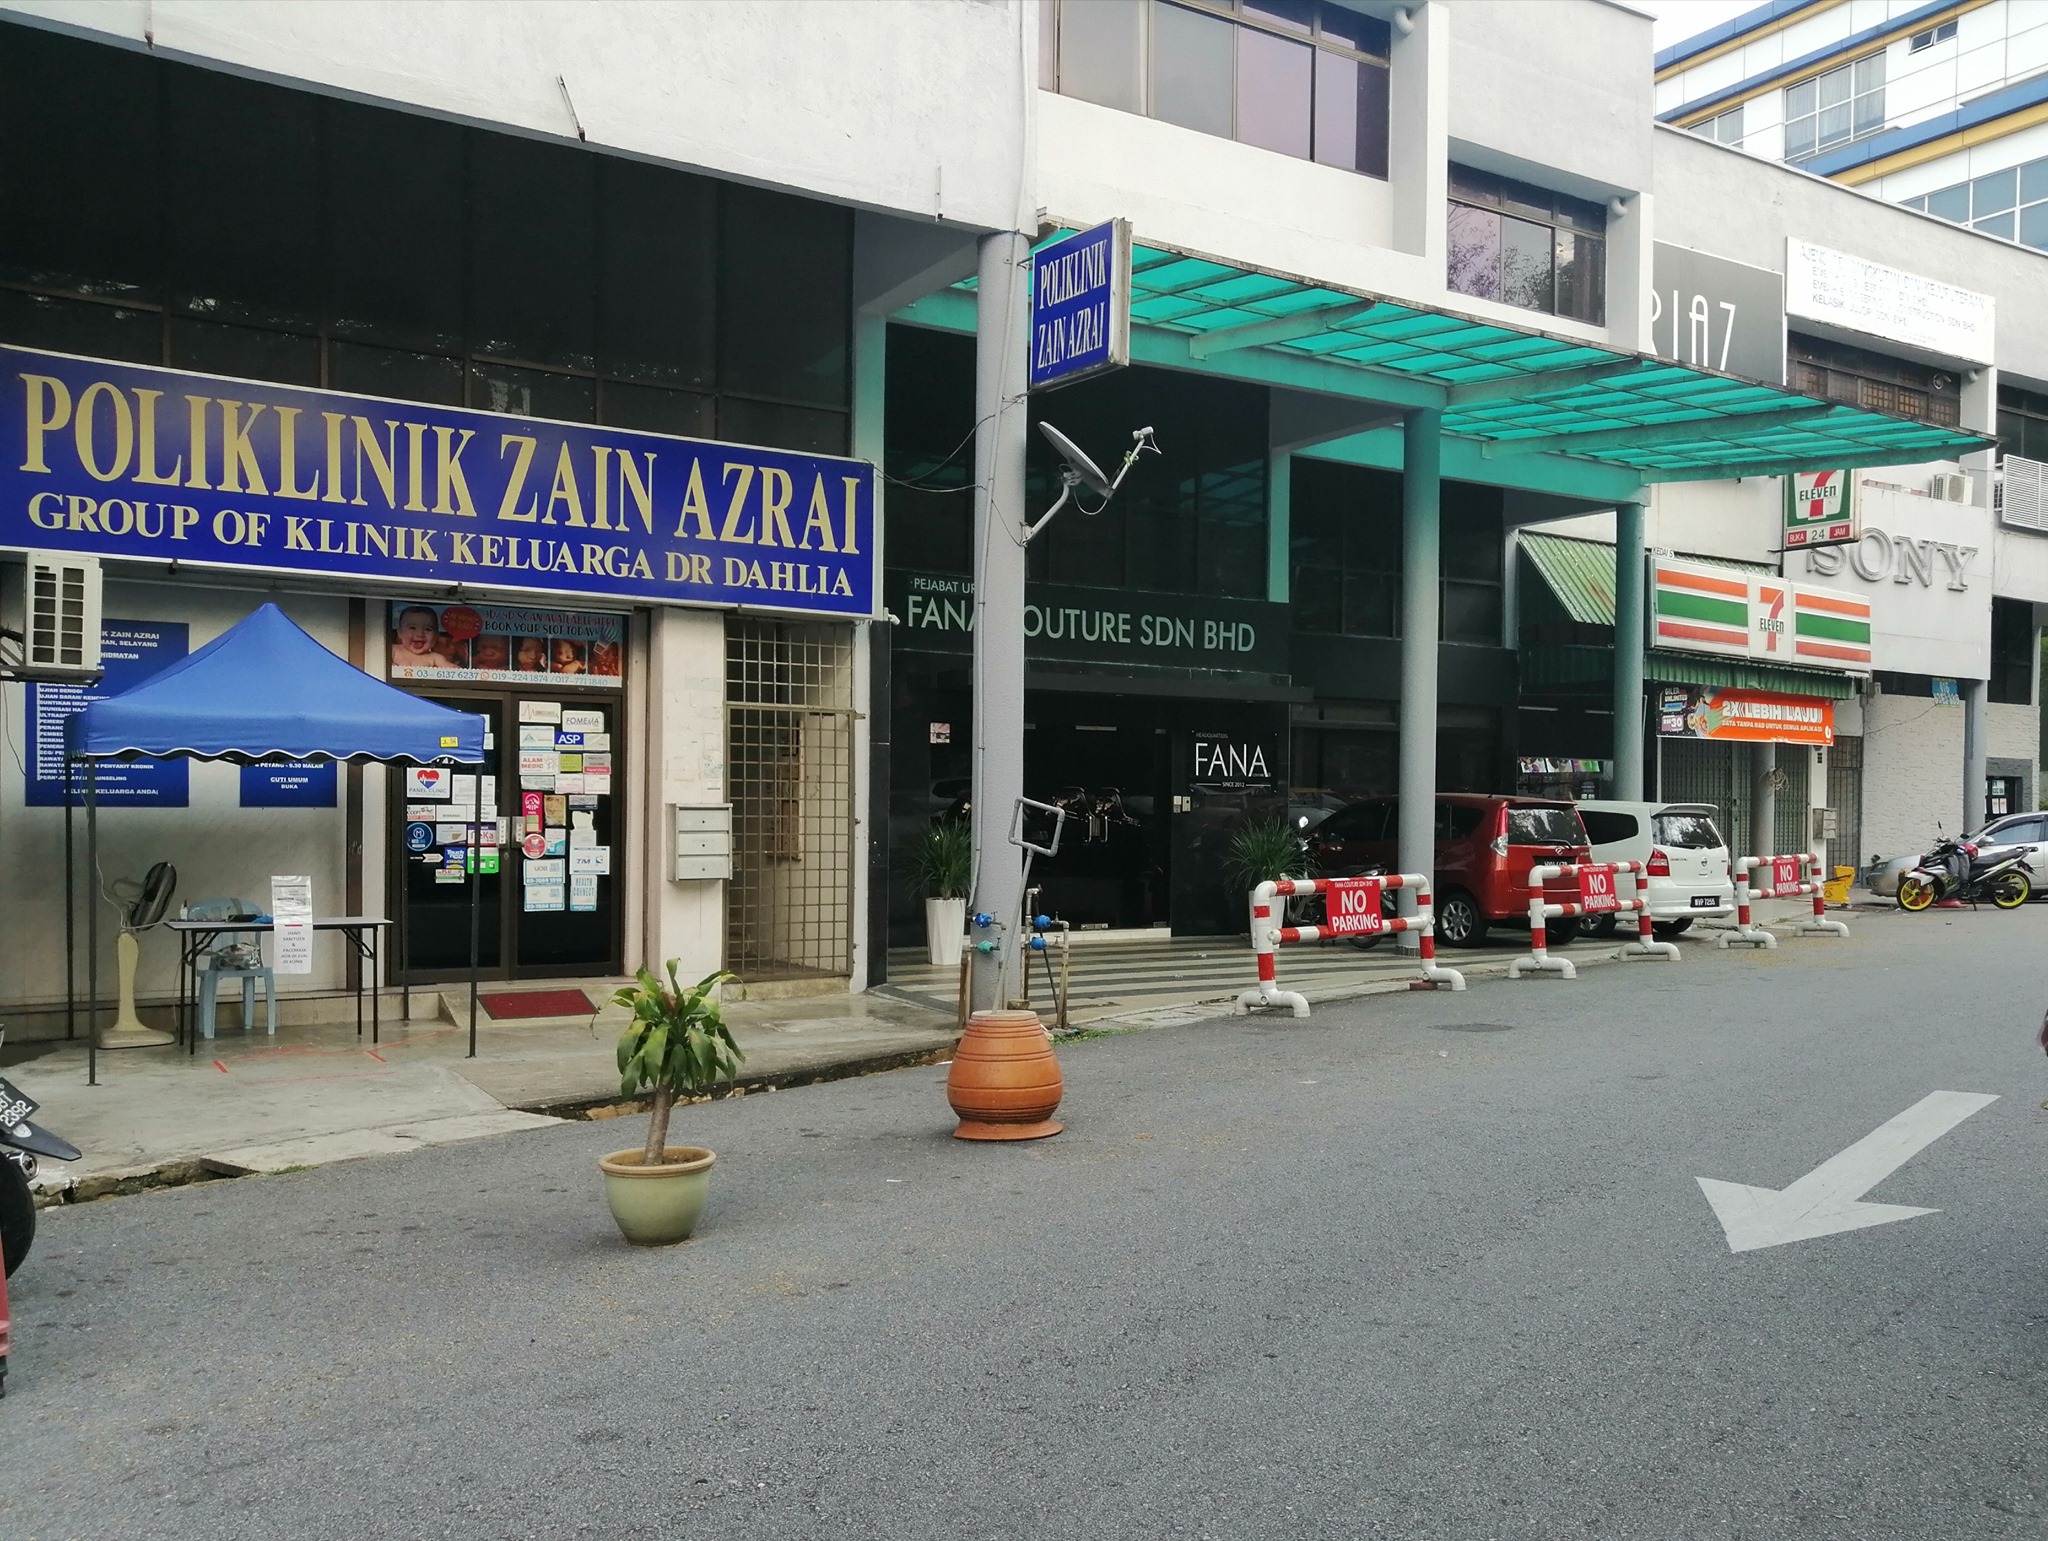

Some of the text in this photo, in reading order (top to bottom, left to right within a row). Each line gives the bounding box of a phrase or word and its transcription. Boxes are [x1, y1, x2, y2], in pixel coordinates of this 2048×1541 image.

[1039, 239, 1107, 309] POLIKLINIK
[1037, 302, 1105, 369] ZAIN AZRAI
[19, 373, 860, 555] POLIKLINIK ZAIN AZRAI
[1799, 485, 1837, 501] ELEVEN
[1789, 527, 1846, 543] BUKA 24 JAM
[28, 492, 853, 597] GROUP OF KLINIK KELUARGA DR DAHLIA
[1806, 527, 1978, 592] SONY
[914, 578, 958, 594] PEJABAT
[517, 611, 542, 622] SCAN
[1759, 617, 1784, 633] ELEVEN
[133, 632, 160, 640] AZRAI
[485, 620, 512, 631] BOOK
[513, 623, 540, 634] YOUR
[542, 624, 563, 635] SLOT
[1023, 604, 1131, 643] OUTURE
[1140, 614, 1195, 649] SDN
[1204, 620, 1256, 653] BHD
[100, 651, 139, 660] HIDMATAN
[437, 670, 456, 680] 6137
[457, 671, 479, 681] 6237
[530, 674, 548, 682] 1874
[588, 678, 608, 686] 1840
[1744, 703, 1782, 720] LEBIH
[1786, 706, 1823, 724] LAJU
[1671, 717, 1683, 728] 30
[1721, 719, 1736, 727] DATA
[558, 734, 581, 744] ASP
[1195, 742, 1269, 778] FANA
[1779, 864, 1793, 882] NO
[1588, 873, 1607, 895] NO
[1776, 881, 1799, 895] PARKING
[1341, 889, 1367, 915] NO
[1583, 893, 1616, 910] PARKING
[1331, 913, 1380, 933] PARKING
[0, 1100, 33, 1127] 2392
